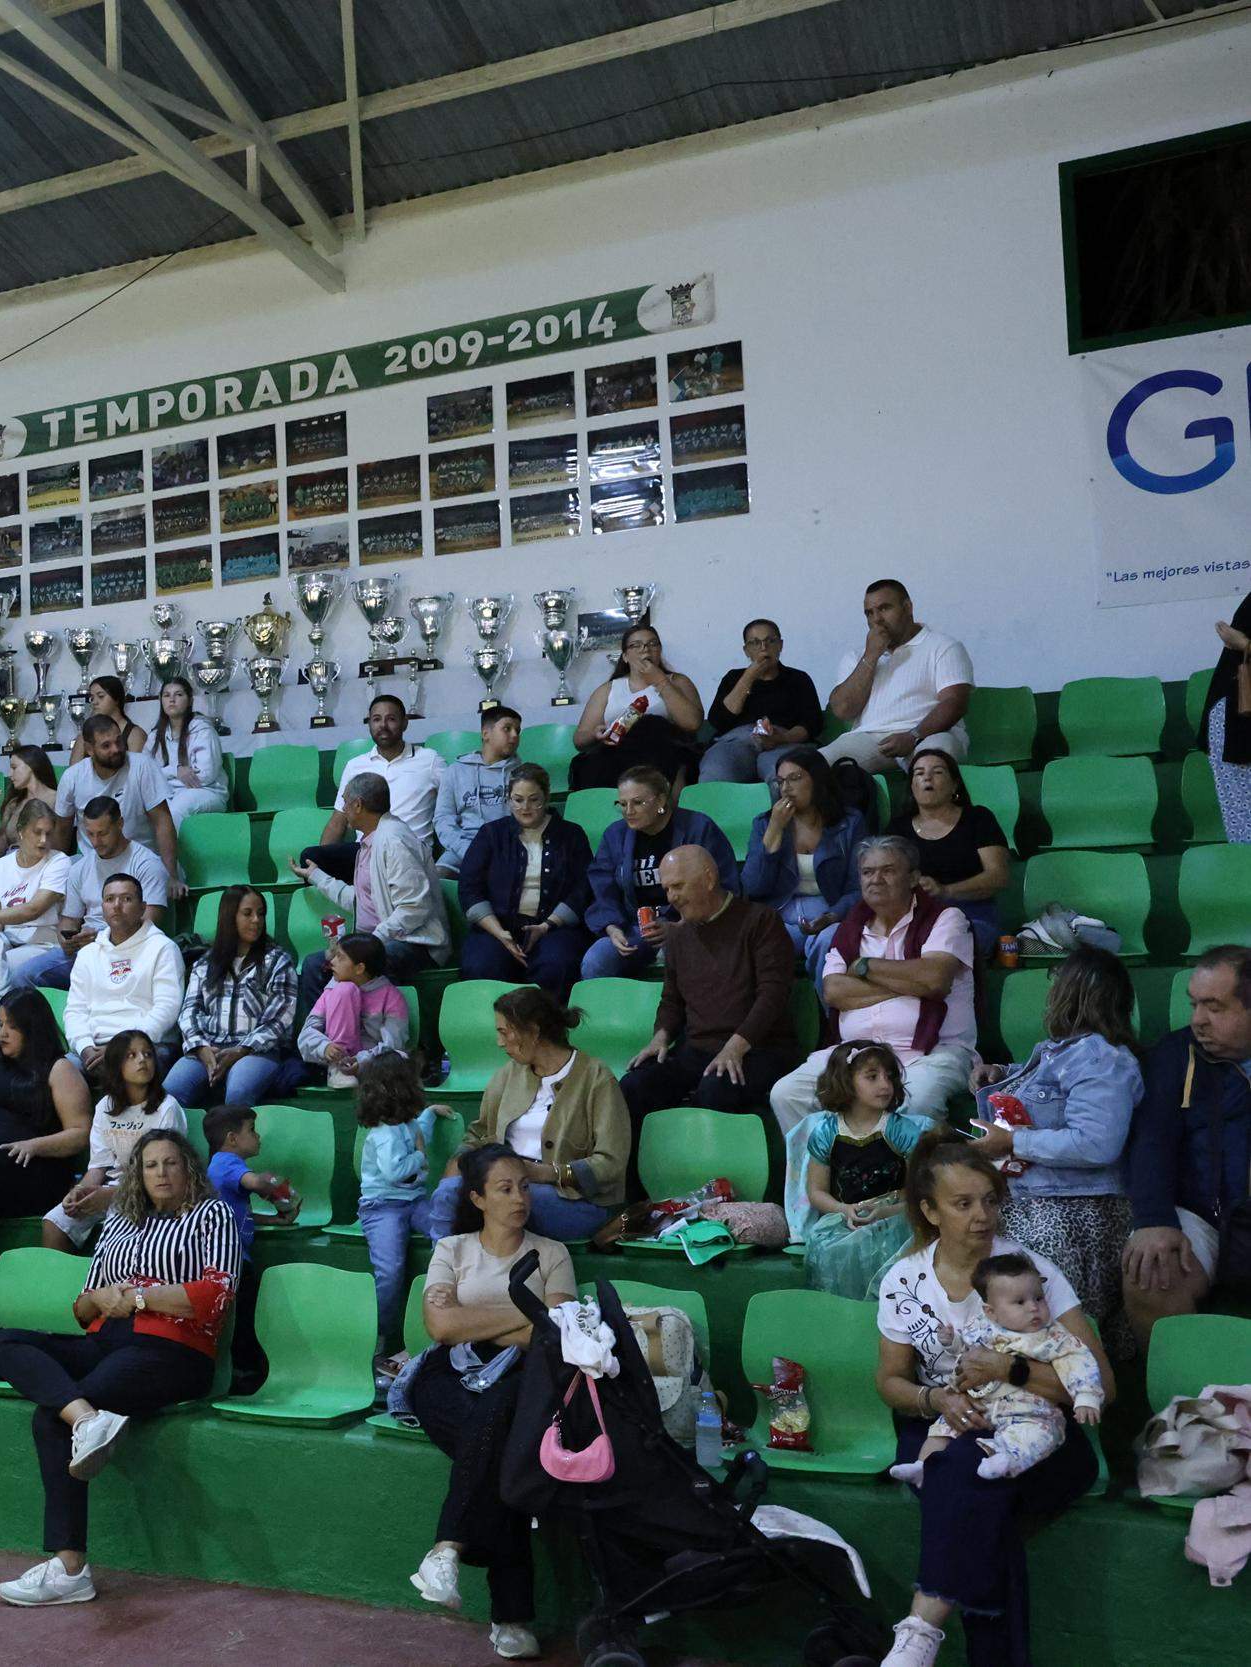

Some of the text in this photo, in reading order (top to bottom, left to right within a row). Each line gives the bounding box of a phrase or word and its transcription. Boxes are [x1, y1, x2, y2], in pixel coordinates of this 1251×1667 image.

[41, 300, 618, 448] TEMPORADA 2009-2014
[1106, 360, 1251, 495] G
[1143, 565, 1200, 581] mejores
[1204, 560, 1251, 573] vistas
